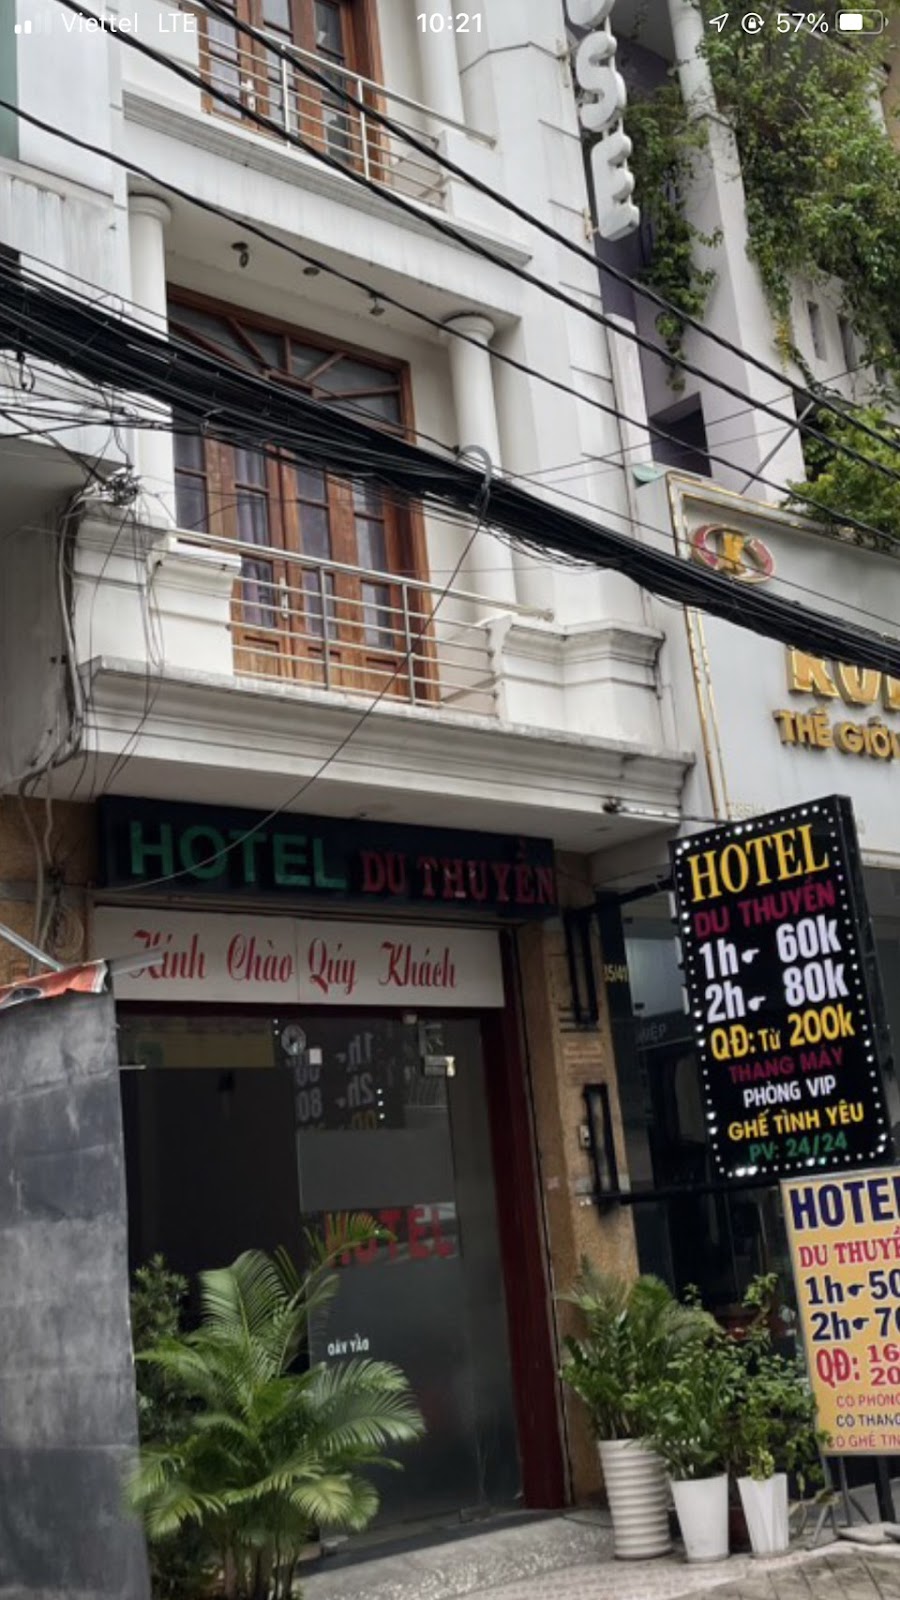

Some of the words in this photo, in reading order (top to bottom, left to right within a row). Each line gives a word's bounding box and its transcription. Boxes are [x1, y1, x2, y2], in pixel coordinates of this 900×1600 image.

[129, 821, 346, 888] HOTEL
[361, 850, 406, 892] DU
[687, 823, 830, 903] HOTEL
[695, 906, 731, 938] DU
[227, 932, 294, 983] Chào
[379, 940, 457, 988] Khách
[699, 938, 739, 980] 1h
[775, 914, 842, 963] 60k
[705, 980, 746, 1024] 2h
[782, 958, 849, 1008] 80k
[711, 1023, 756, 1061] QĐ:
[758, 1027, 781, 1052] Từ
[788, 1003, 856, 1048] 200k
[729, 1055, 795, 1084] THANG
[801, 1043, 845, 1071] MÁY
[743, 1080, 801, 1109] PHÒNG
[806, 1074, 837, 1099] VIP
[728, 1109, 770, 1142] GHẾ
[773, 1108, 821, 1134] TÌNH
[825, 1098, 865, 1127] YÊU
[786, 1130, 848, 1158] 24/24
[799, 1244, 828, 1268] DU
[805, 1274, 845, 1305] 1h
[810, 1311, 851, 1341] 2h
[816, 1348, 860, 1389] QĐ:
